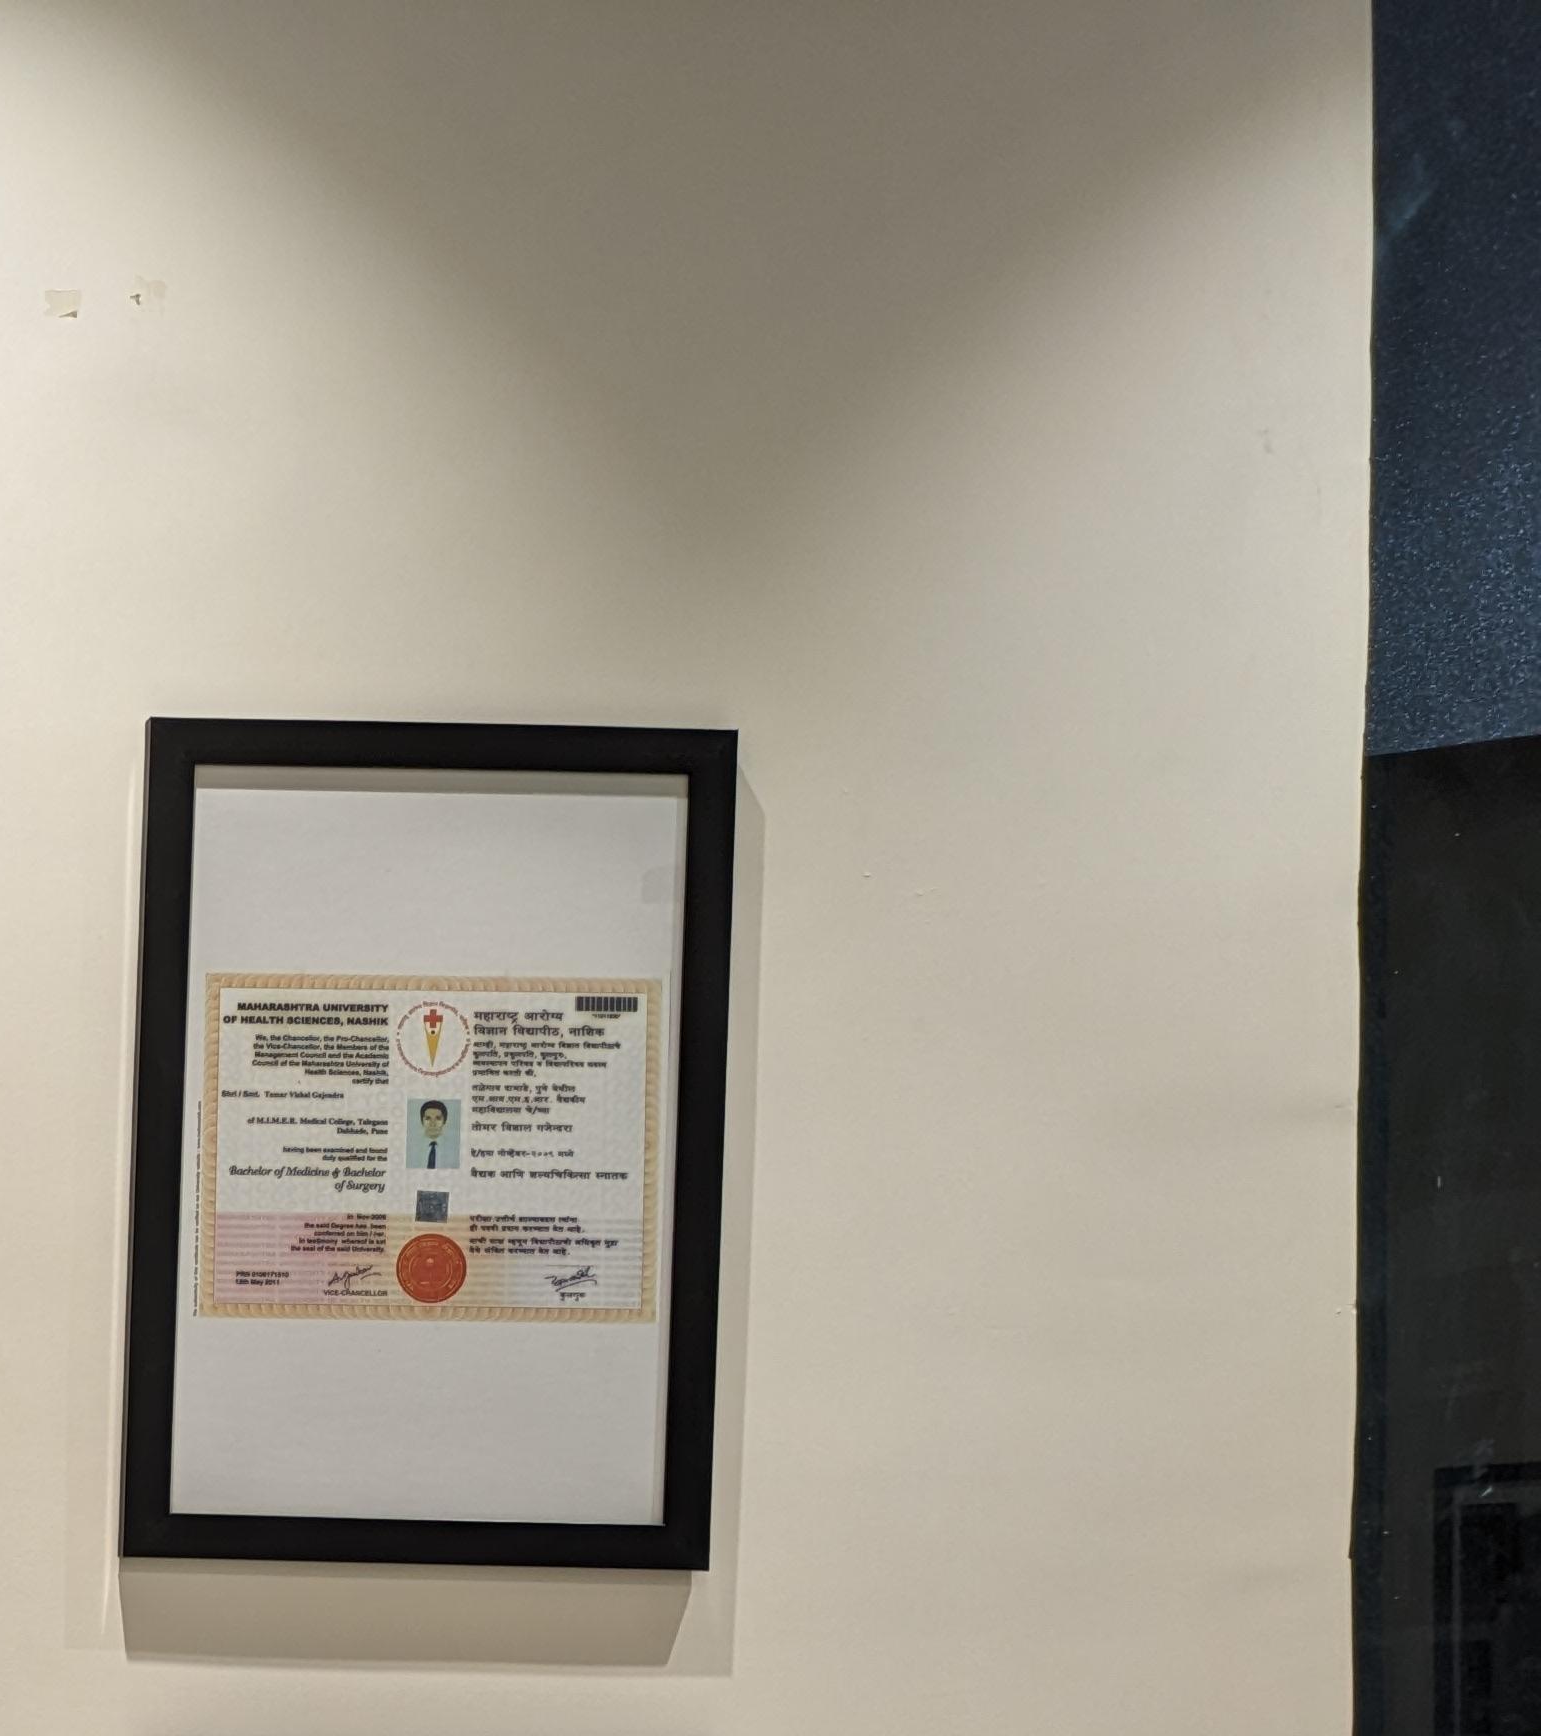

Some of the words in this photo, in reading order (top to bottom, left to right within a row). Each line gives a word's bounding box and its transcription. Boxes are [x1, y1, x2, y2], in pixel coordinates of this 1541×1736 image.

[237, 1002, 320, 1012] MAHARASHTRA
[323, 1004, 389, 1012] UNIVERSITY
[223, 1016, 237, 1024] OF
[240, 1016, 284, 1024] HEALTH
[287, 1017, 344, 1026] SCIENCES,
[347, 1017, 389, 1026] NASHIK
[229, 1165, 272, 1177] Bachelor
[274, 1166, 286, 1179] of
[285, 1166, 329, 1177] Medicine
[342, 1167, 386, 1178] Bachelor
[335, 1180, 346, 1192] of
[346, 1180, 385, 1193] Surgery
